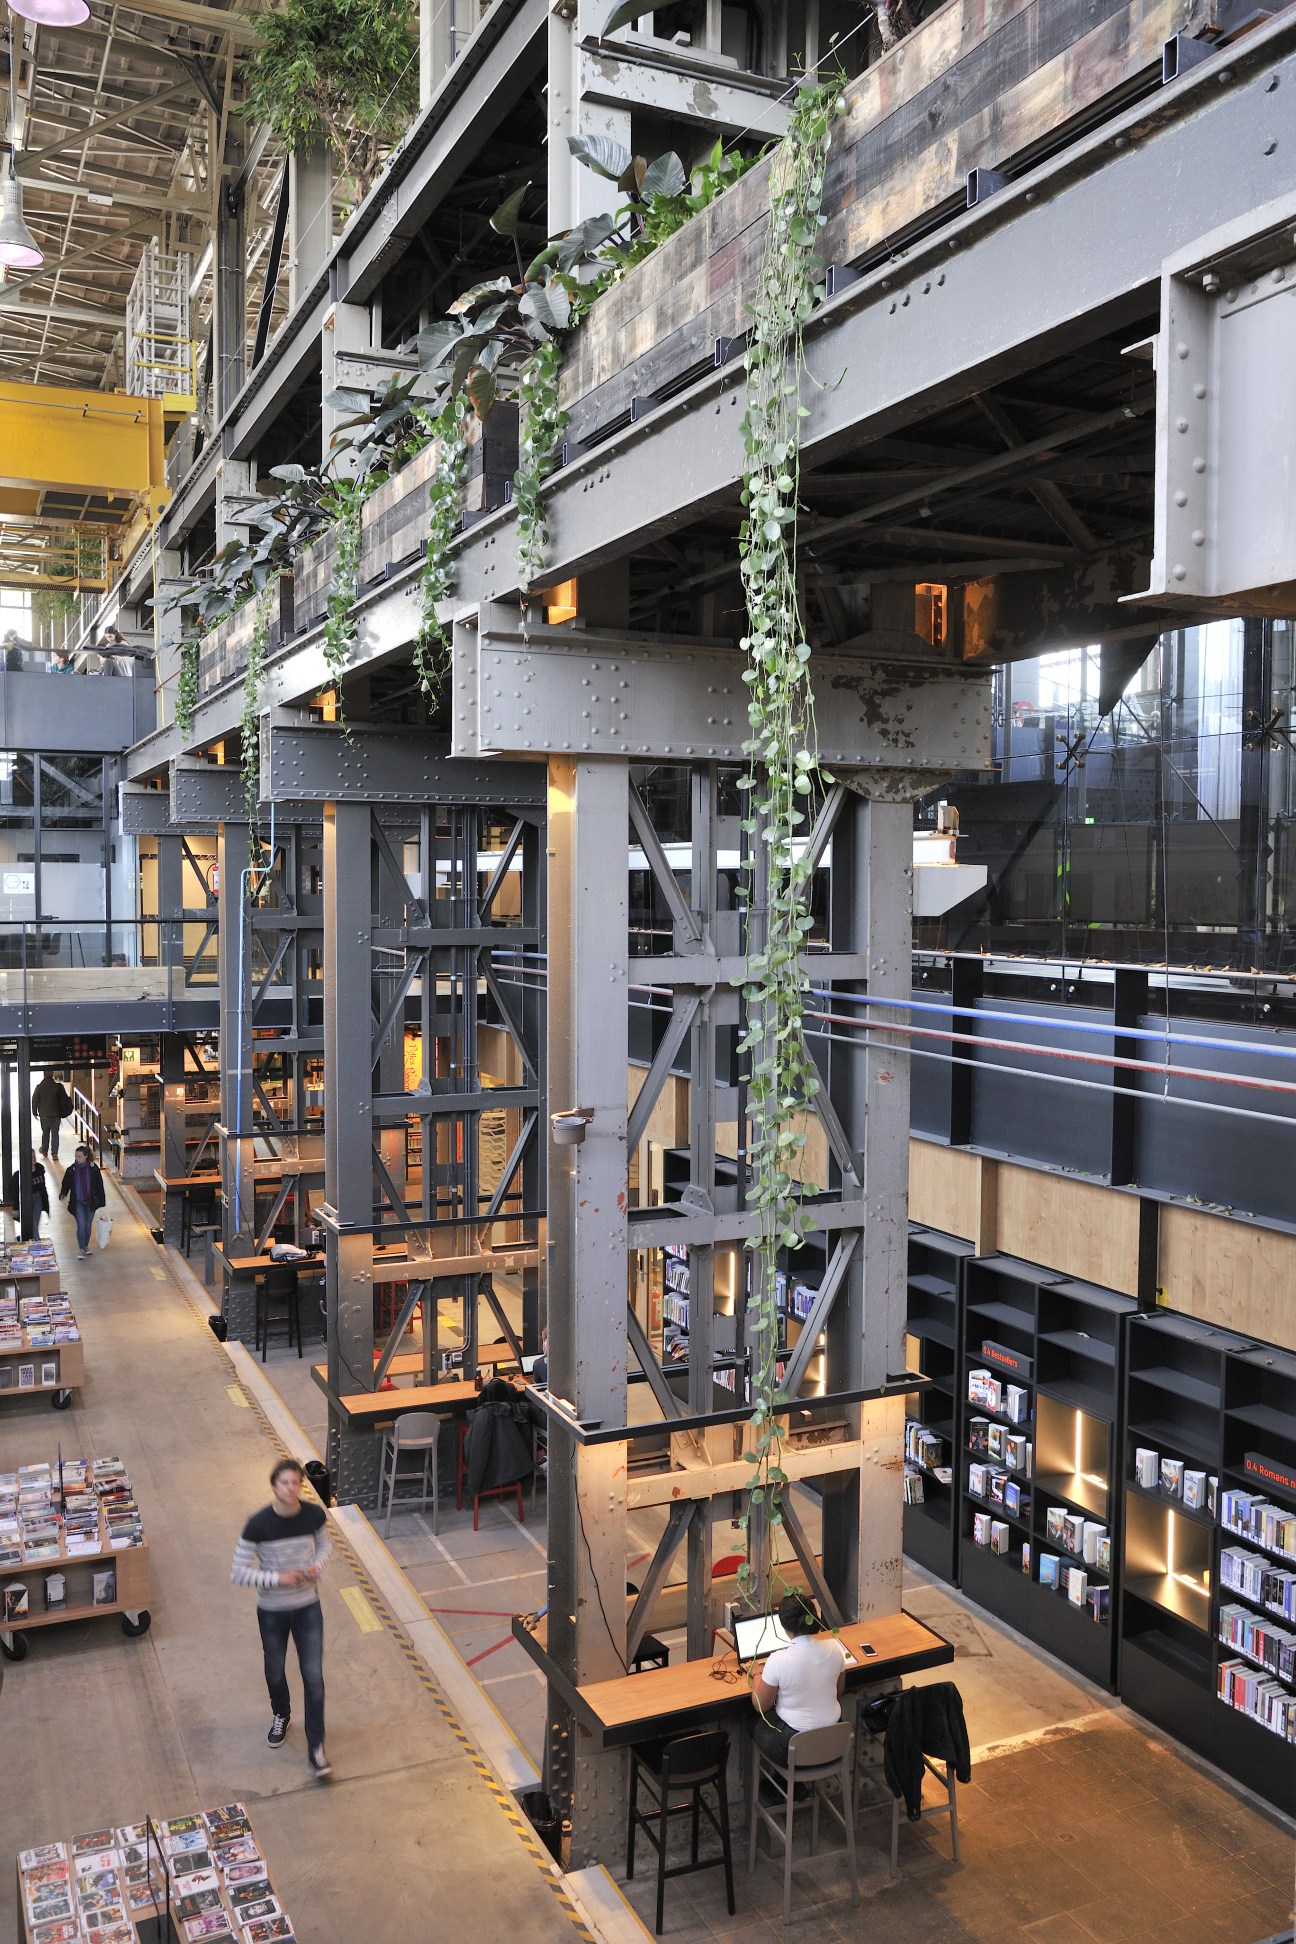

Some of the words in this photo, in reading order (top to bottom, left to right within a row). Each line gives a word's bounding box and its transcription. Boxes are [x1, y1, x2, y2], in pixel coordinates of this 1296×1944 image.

[991, 1349, 1018, 1368] Bestsellers
[1246, 1459, 1258, 1472] 0.4
[1259, 1464, 1289, 1486] Romans
